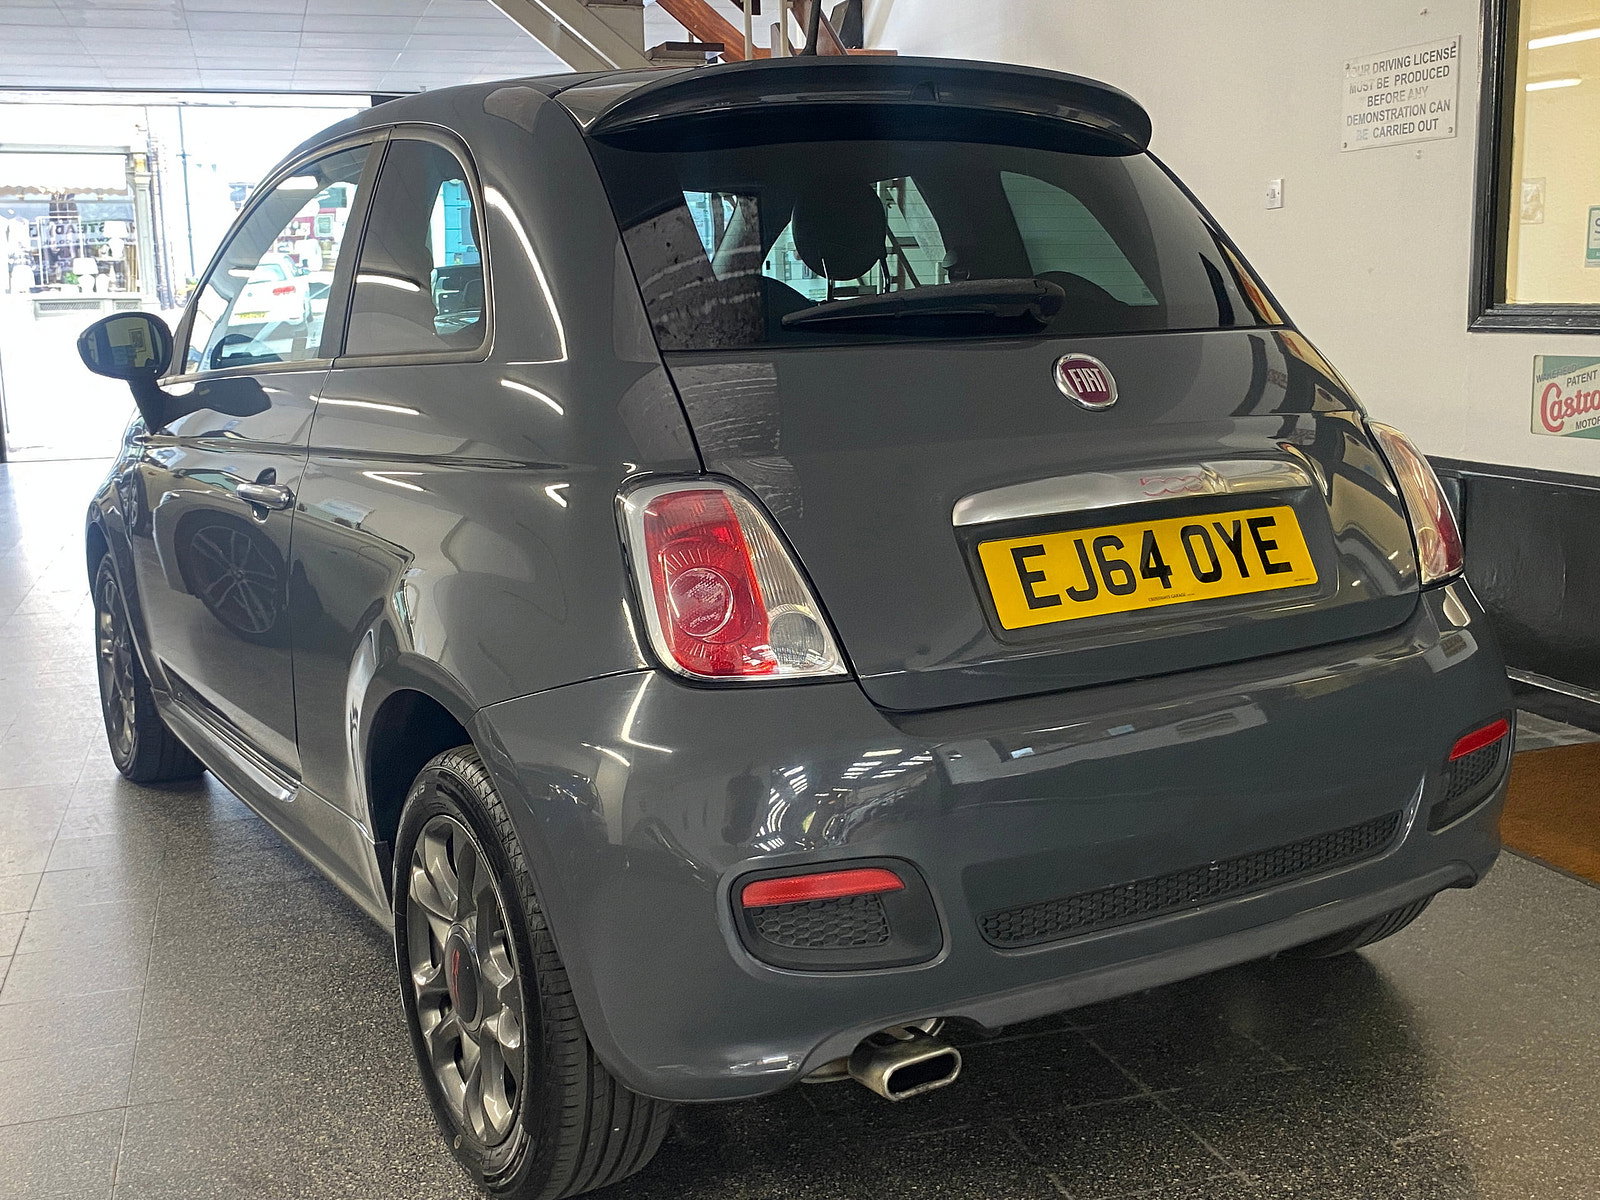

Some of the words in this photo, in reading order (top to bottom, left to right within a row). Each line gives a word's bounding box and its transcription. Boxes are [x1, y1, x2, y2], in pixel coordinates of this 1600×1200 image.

[1372, 55, 1411, 75] DRIVING
[1413, 46, 1457, 66] LICENSE
[1376, 76, 1390, 90] BE
[1394, 65, 1450, 87] PRODUCED
[1367, 90, 1406, 108] BEFORE
[1346, 103, 1426, 127] DEMONSTRATION
[1429, 99, 1451, 114] CAN
[1372, 122, 1415, 139] CARRIED
[1417, 118, 1439, 132] OUT
[1069, 368, 1107, 393] FIAT
[1566, 369, 1598, 387] PATENT
[1010, 530, 1173, 611] EJ64
[1180, 516, 1293, 584] OYE
